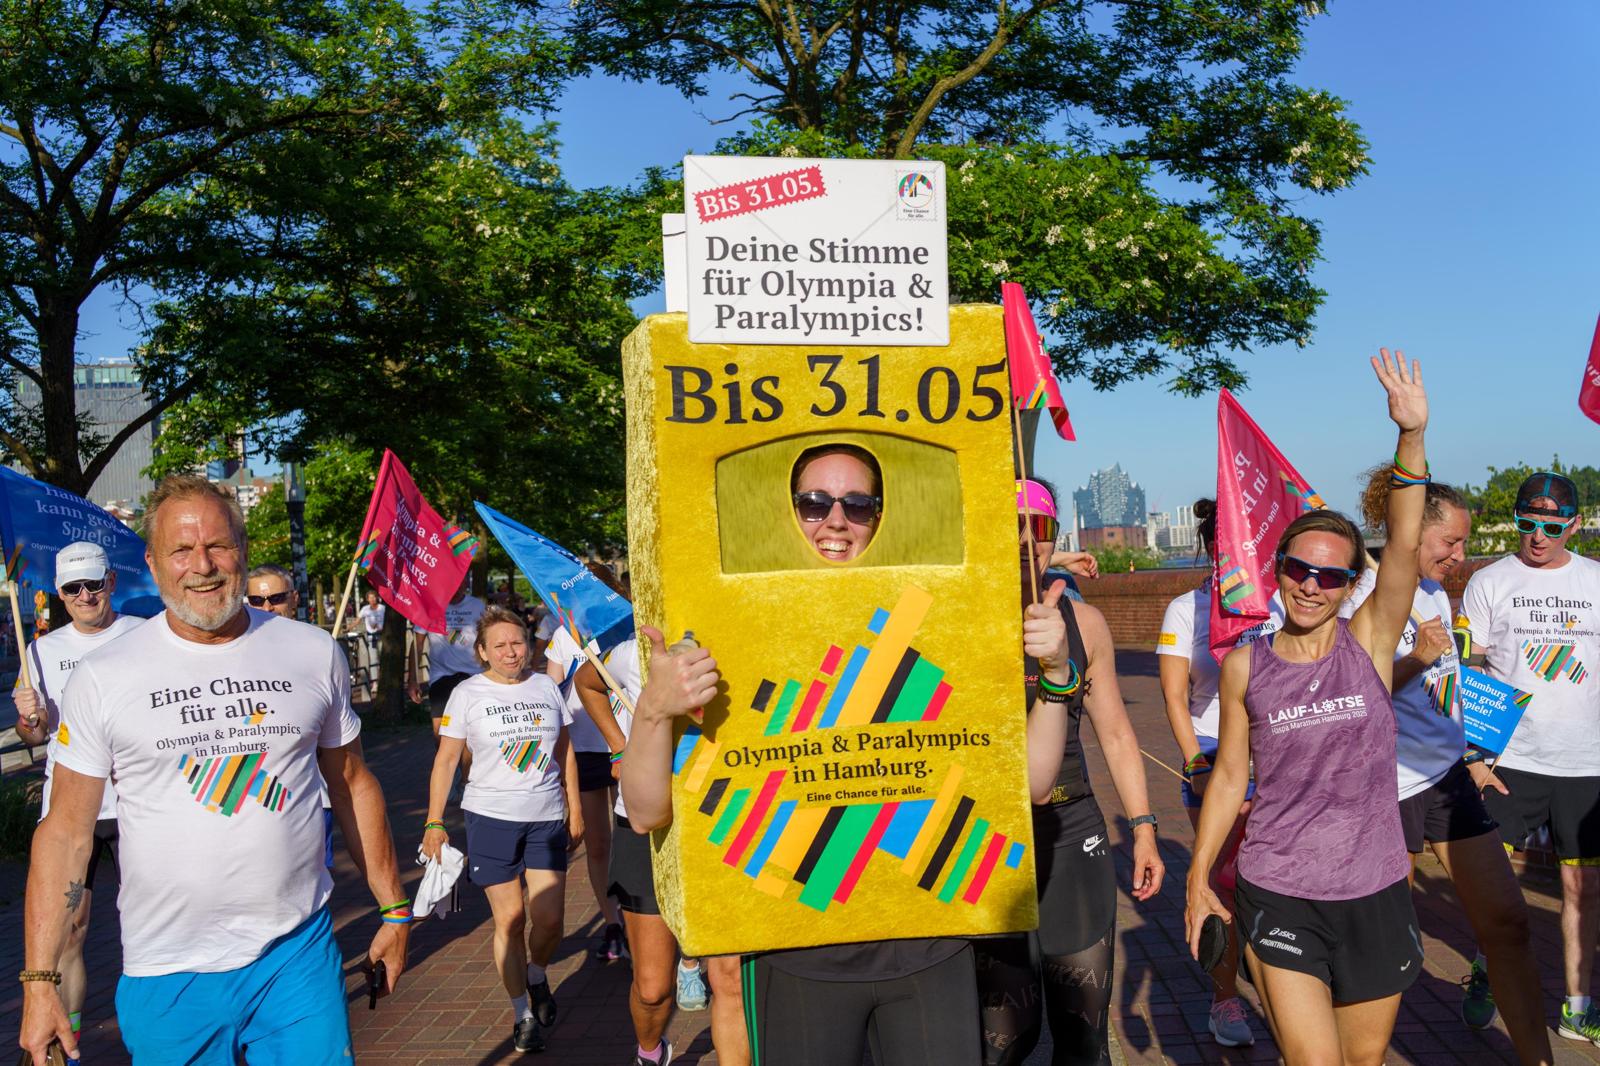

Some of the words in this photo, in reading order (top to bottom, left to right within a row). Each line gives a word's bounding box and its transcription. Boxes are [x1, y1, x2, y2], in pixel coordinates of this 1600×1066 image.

[701, 191, 741, 216] Bis
[745, 172, 818, 206] 31.05.
[706, 236, 798, 263] Deine
[810, 238, 928, 265] Stimme
[702, 268, 751, 296] für
[761, 270, 896, 304] Olympia
[908, 273, 934, 299] &
[715, 303, 923, 337] Paralympics!
[664, 363, 784, 424] Bis
[807, 354, 1006, 424] 31.05
[35, 500, 83, 520] kann
[62, 521, 117, 548] Spiele!
[429, 533, 441, 549] &
[1512, 596, 1543, 608] Eine
[1529, 610, 1548, 623] für
[1552, 611, 1582, 624] alle.
[1513, 627, 1543, 636] Olympia
[1553, 628, 1594, 637] Paralympics
[60, 659, 80, 671] Ein
[149, 685, 202, 709] Eine
[209, 677, 293, 696] Chance
[1461, 687, 1478, 700] ann
[1478, 695, 1507, 712] große
[1464, 675, 1508, 702] Hamburg
[180, 704, 216, 725] für
[225, 698, 275, 719] alle.
[485, 706, 511, 716] Eine
[501, 714, 519, 725] für
[522, 711, 545, 722] alle.
[1271, 726, 1290, 735] Haspa
[1290, 718, 1321, 730] Marathon
[1321, 713, 1351, 723] Hamburg
[1352, 710, 1368, 718] 2025
[156, 732, 210, 750] Olympia
[214, 729, 225, 740] &
[228, 723, 301, 739] Paralympics
[724, 737, 823, 768] Olympia
[832, 734, 850, 754] &
[856, 728, 991, 751] Paralympics
[195, 747, 208, 758] in
[211, 741, 270, 756] Hamburg.
[793, 765, 816, 784] in
[823, 758, 934, 781] Hamburg.
[806, 792, 832, 803] Eine
[835, 788, 878, 800] Chance
[881, 787, 899, 798] für
[901, 784, 926, 795] alle.
[1260, 938, 1303, 956] FRONTRUNNER
